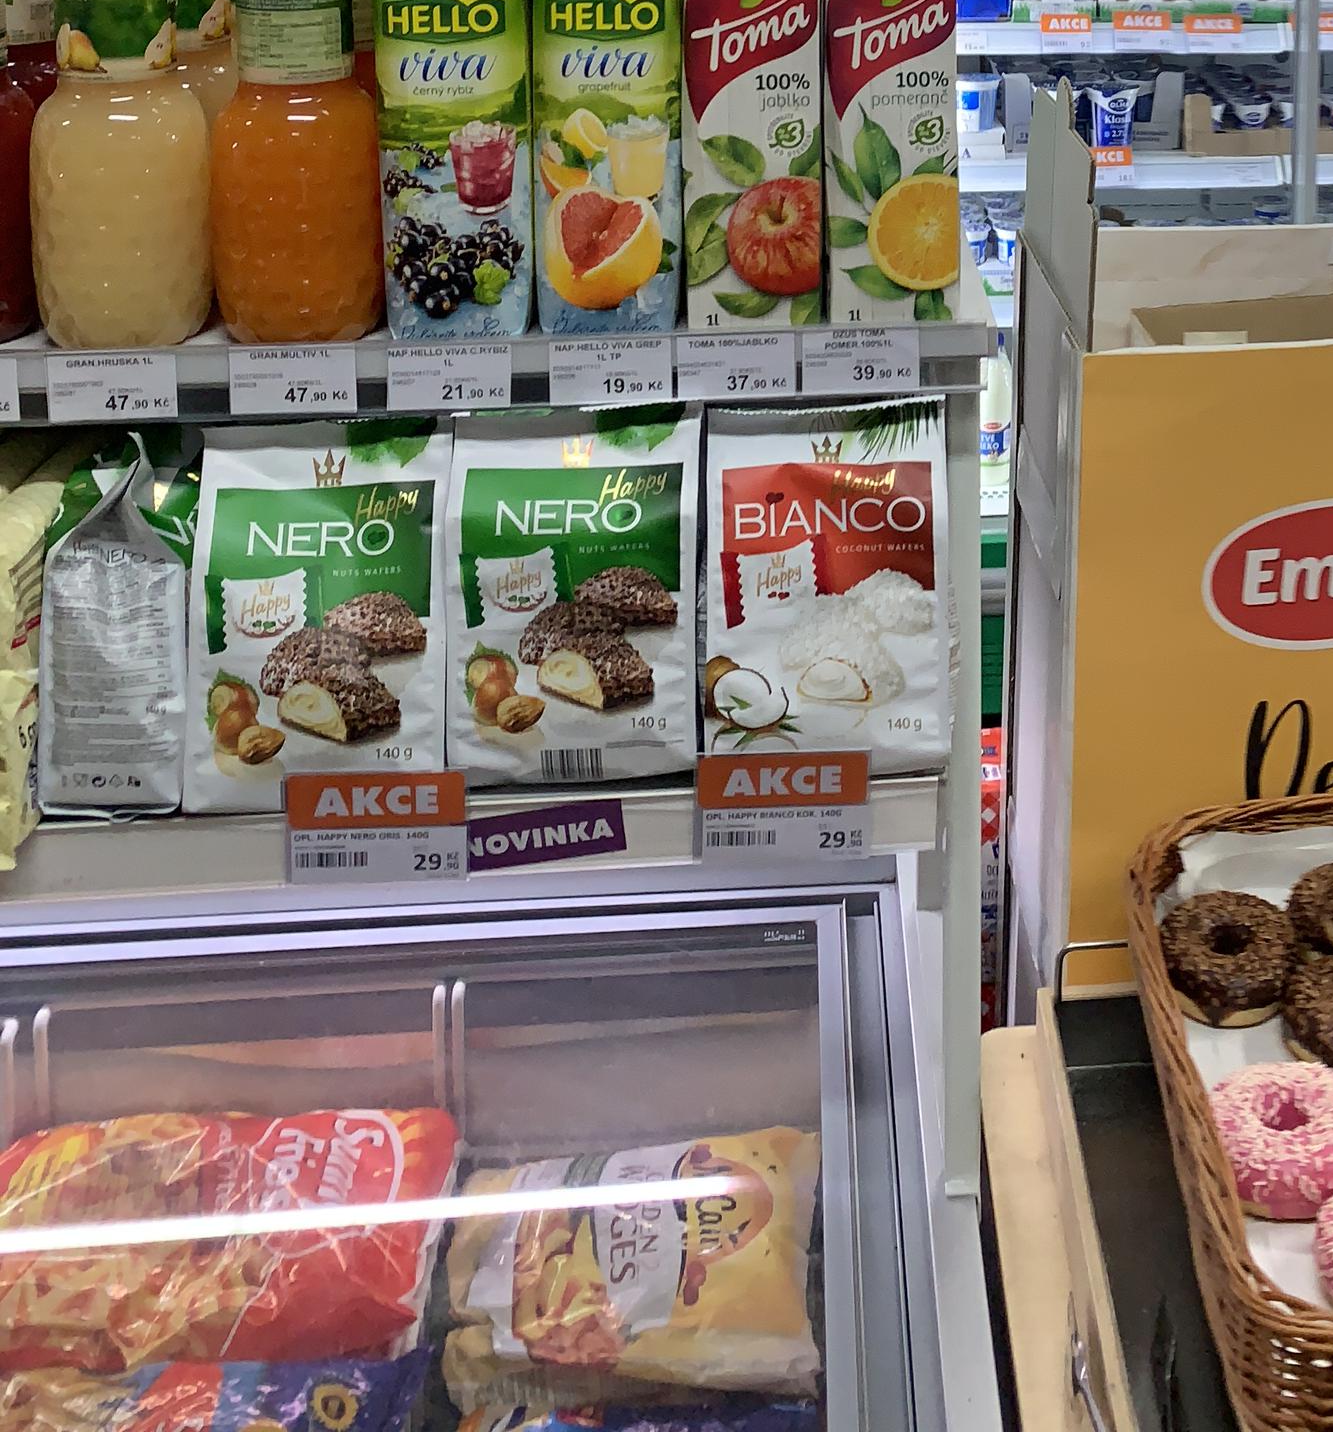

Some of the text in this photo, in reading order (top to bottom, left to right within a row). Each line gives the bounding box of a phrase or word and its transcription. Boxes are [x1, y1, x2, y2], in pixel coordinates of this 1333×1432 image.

[387, 1, 499, 34] HELLO
[551, 0, 659, 32] HELLO
[1049, 17, 1089, 30] AKCE
[1123, 15, 1163, 28] AKCE
[399, 44, 497, 82] viva
[560, 43, 654, 80] viva
[755, 72, 811, 91] 100%
[895, 70, 949, 89] 100%
[759, 90, 811, 112] jablko
[871, 88, 949, 110] pomeranč
[599, 468, 668, 508] Happy
[354, 485, 420, 528] Happy
[494, 498, 642, 536] NERO
[733, 493, 927, 541] BIANCO
[246, 518, 395, 558] NERO
[835, 543, 884, 554] COCONUT
[332, 568, 361, 578] NUTS
[495, 563, 543, 599] Happy
[755, 560, 803, 592] Happy
[240, 591, 293, 627] Happy
[630, 715, 668, 732] 140 g
[886, 717, 923, 732] 140 g
[375, 747, 413, 763] 140 g
[722, 765, 843, 798] AKCE
[314, 784, 441, 818] AKCE
[470, 817, 615, 858] NOVINKA
[818, 830, 846, 849] 29
[413, 853, 442, 871] 29
